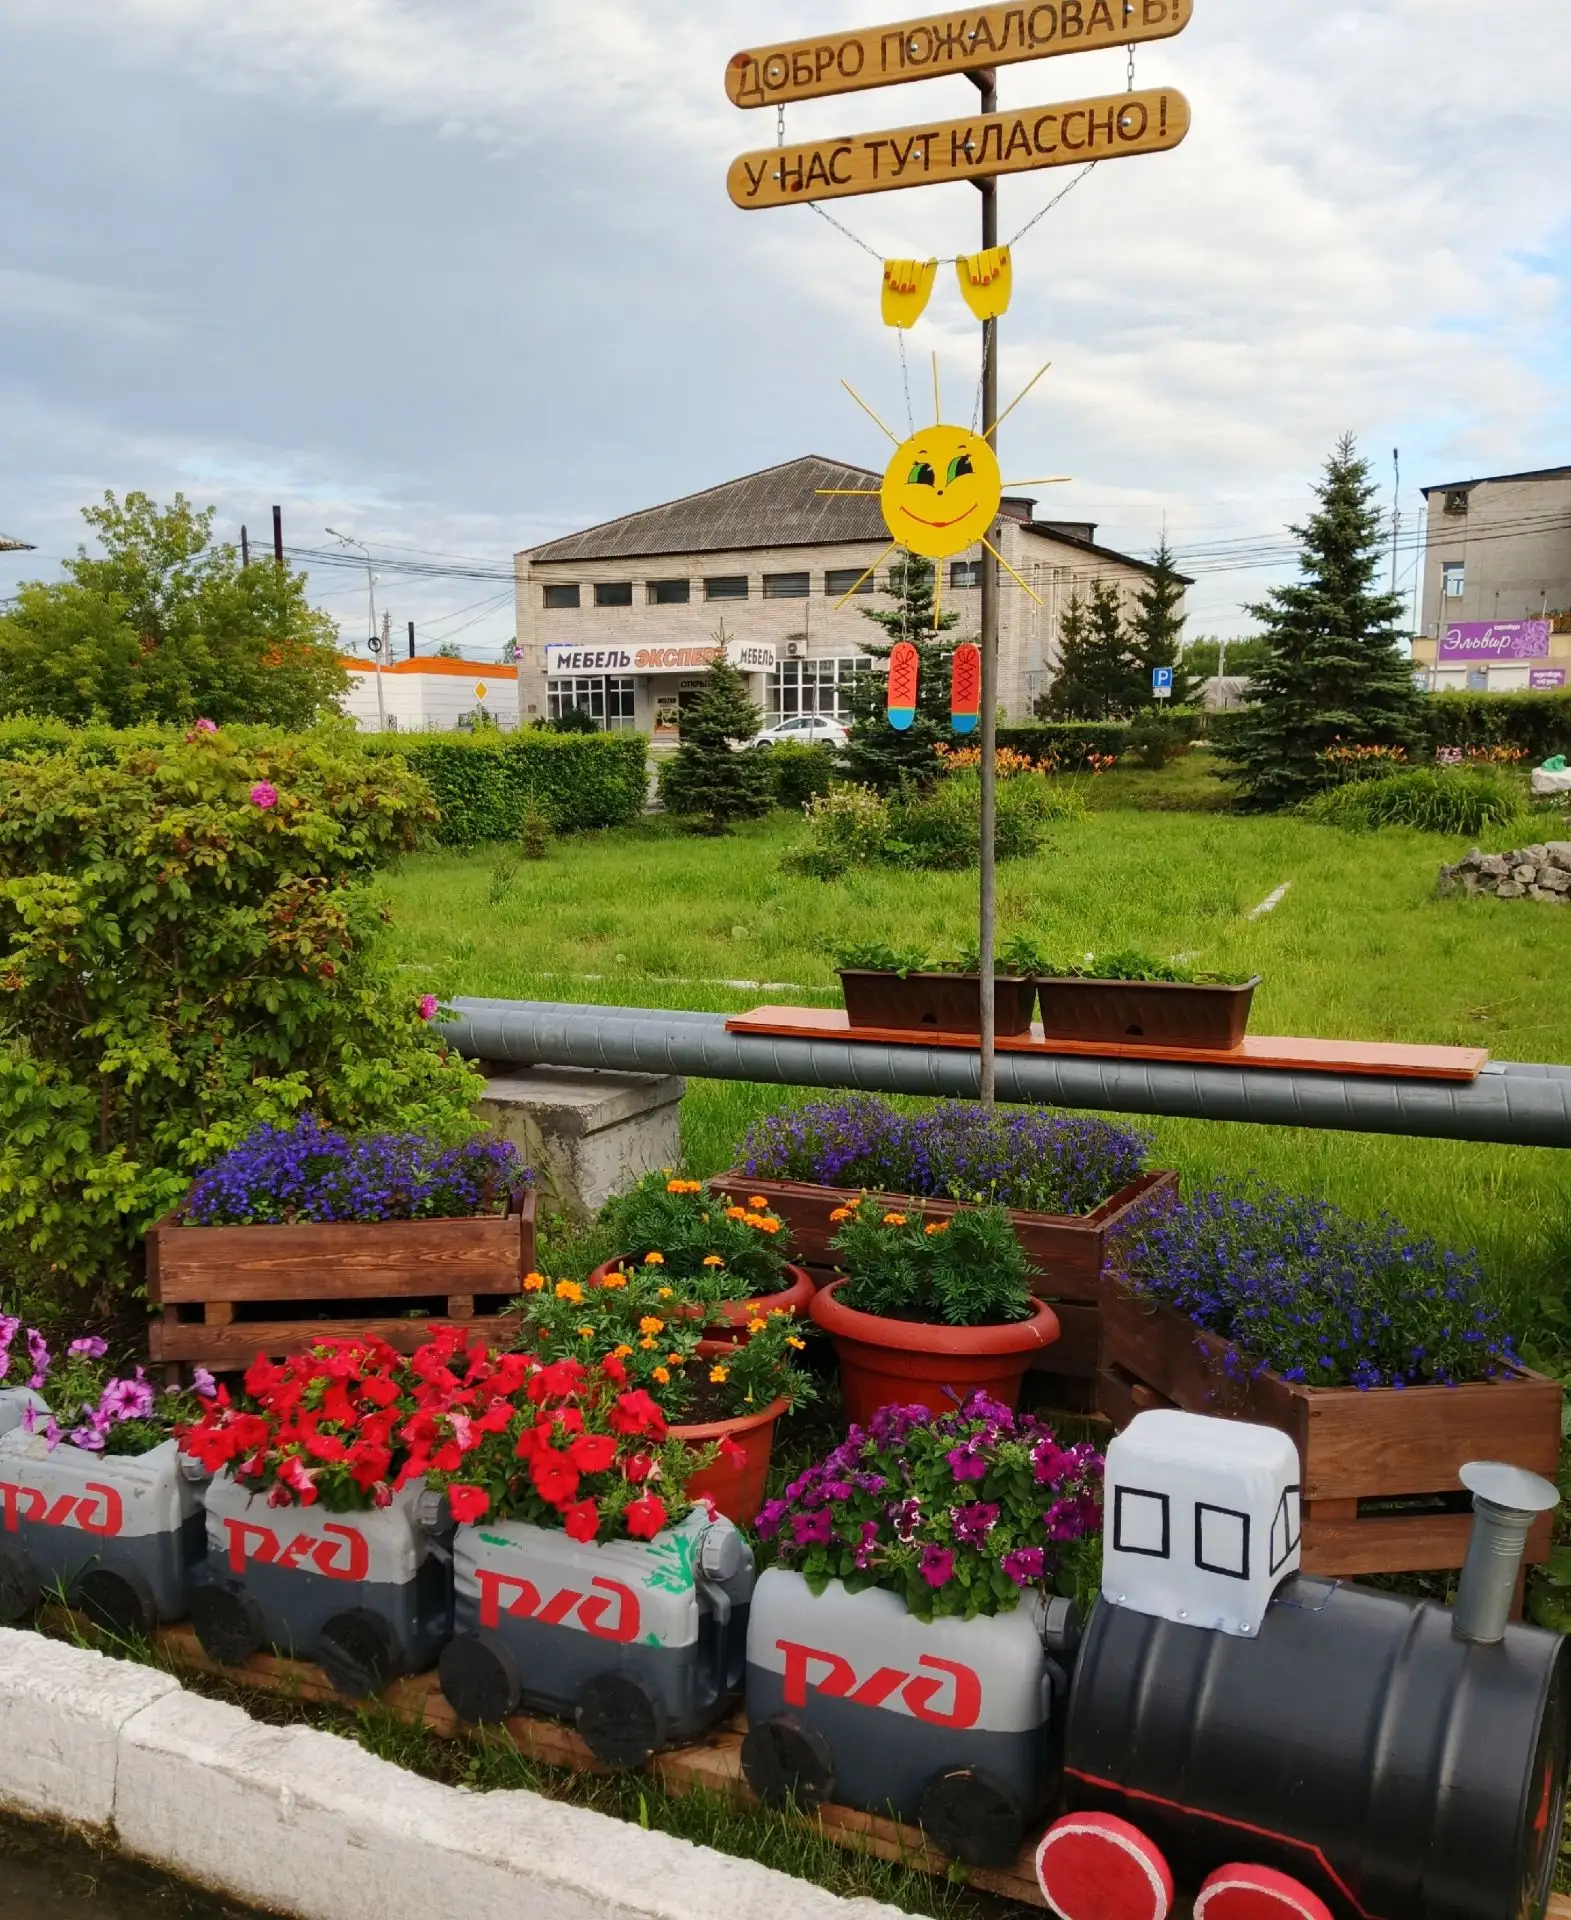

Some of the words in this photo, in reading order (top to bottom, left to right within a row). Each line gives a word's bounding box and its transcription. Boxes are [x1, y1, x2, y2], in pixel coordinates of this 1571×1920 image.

[735, 38, 865, 103] ДОБРО
[880, 0, 1179, 71] ПОЖАЛОВАТЬ!
[743, 160, 768, 197] У
[777, 147, 853, 192] НАС
[863, 132, 939, 179] ТУТ
[557, 651, 631, 669] МЕБЕЛЬ
[740, 647, 774, 666] МЕБЕЛЬ
